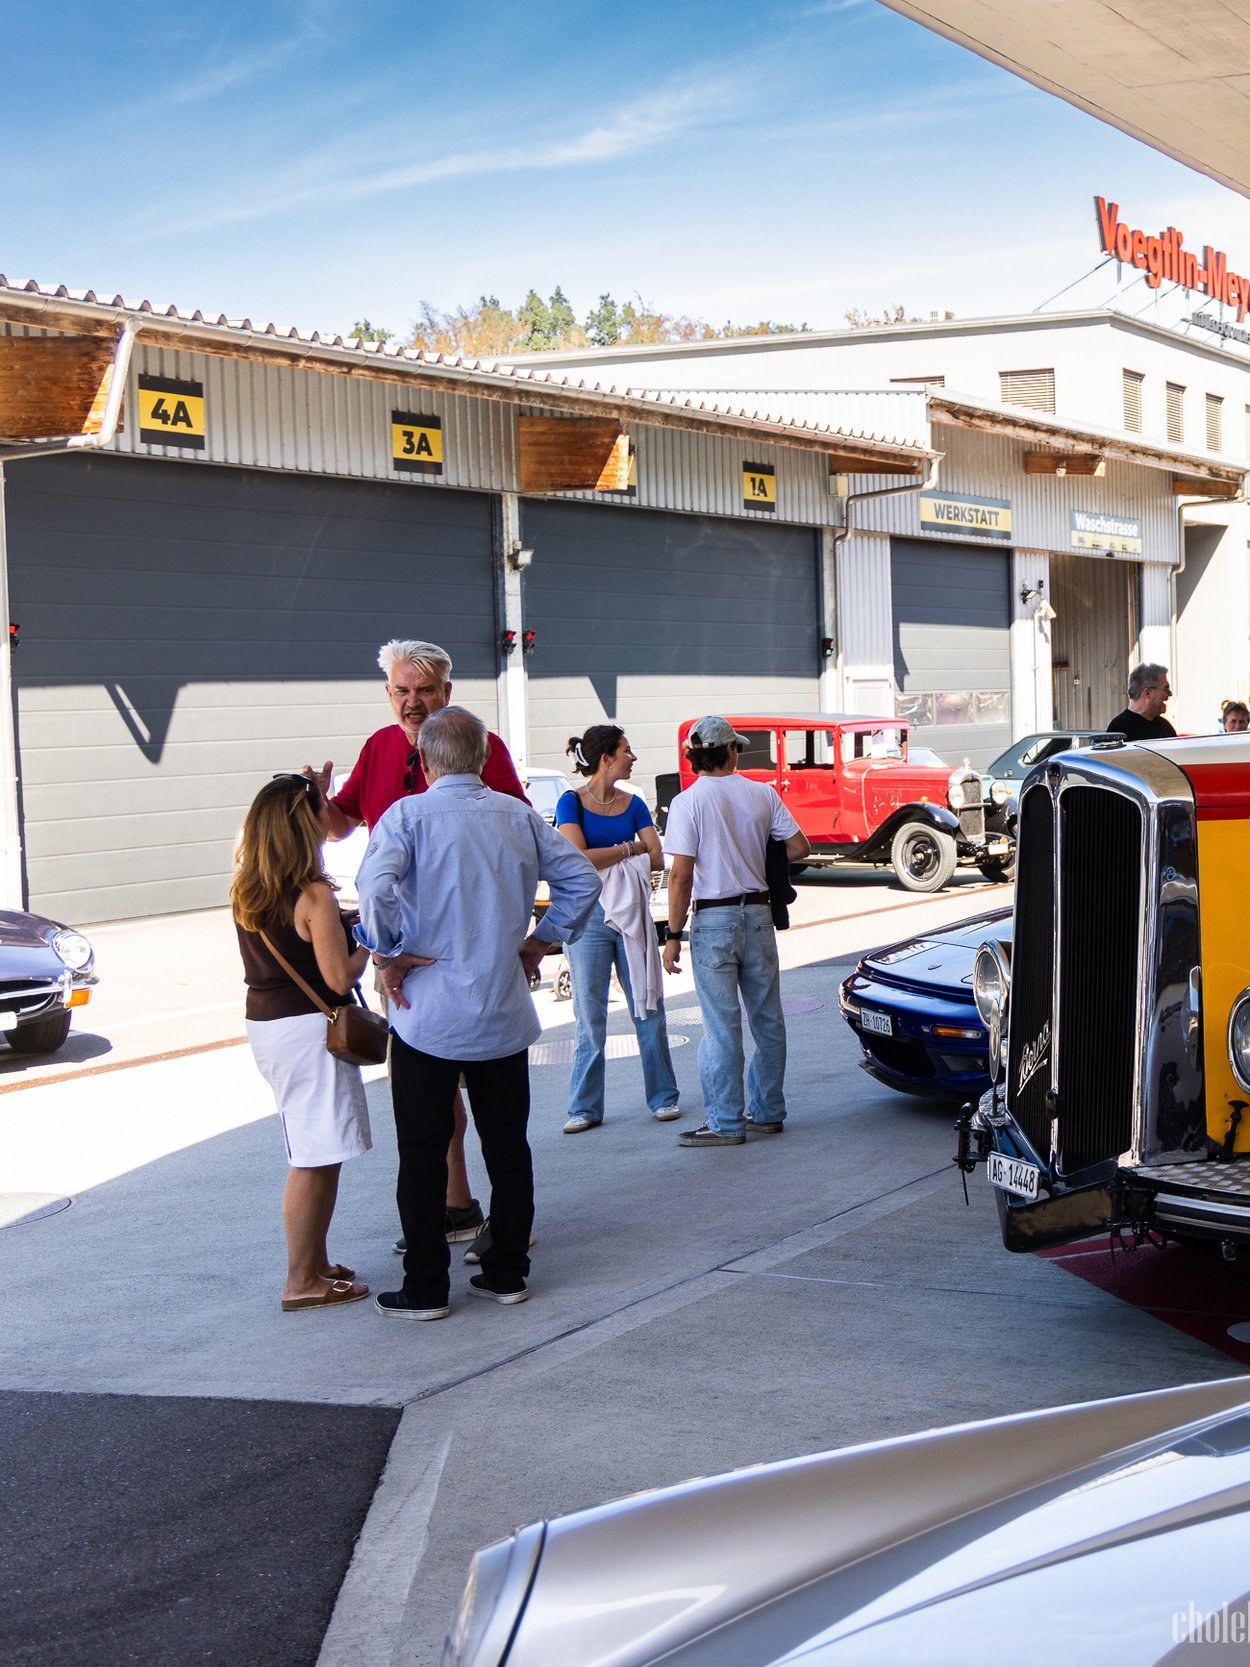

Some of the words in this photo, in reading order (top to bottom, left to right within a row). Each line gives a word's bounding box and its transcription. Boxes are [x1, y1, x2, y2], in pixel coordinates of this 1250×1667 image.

[151, 398, 193, 428] 4A
[402, 430, 433, 456] 3A
[750, 477, 768, 497] 1A
[934, 502, 1000, 527] WERKSTATT
[1074, 512, 1138, 537] Waschstrasse
